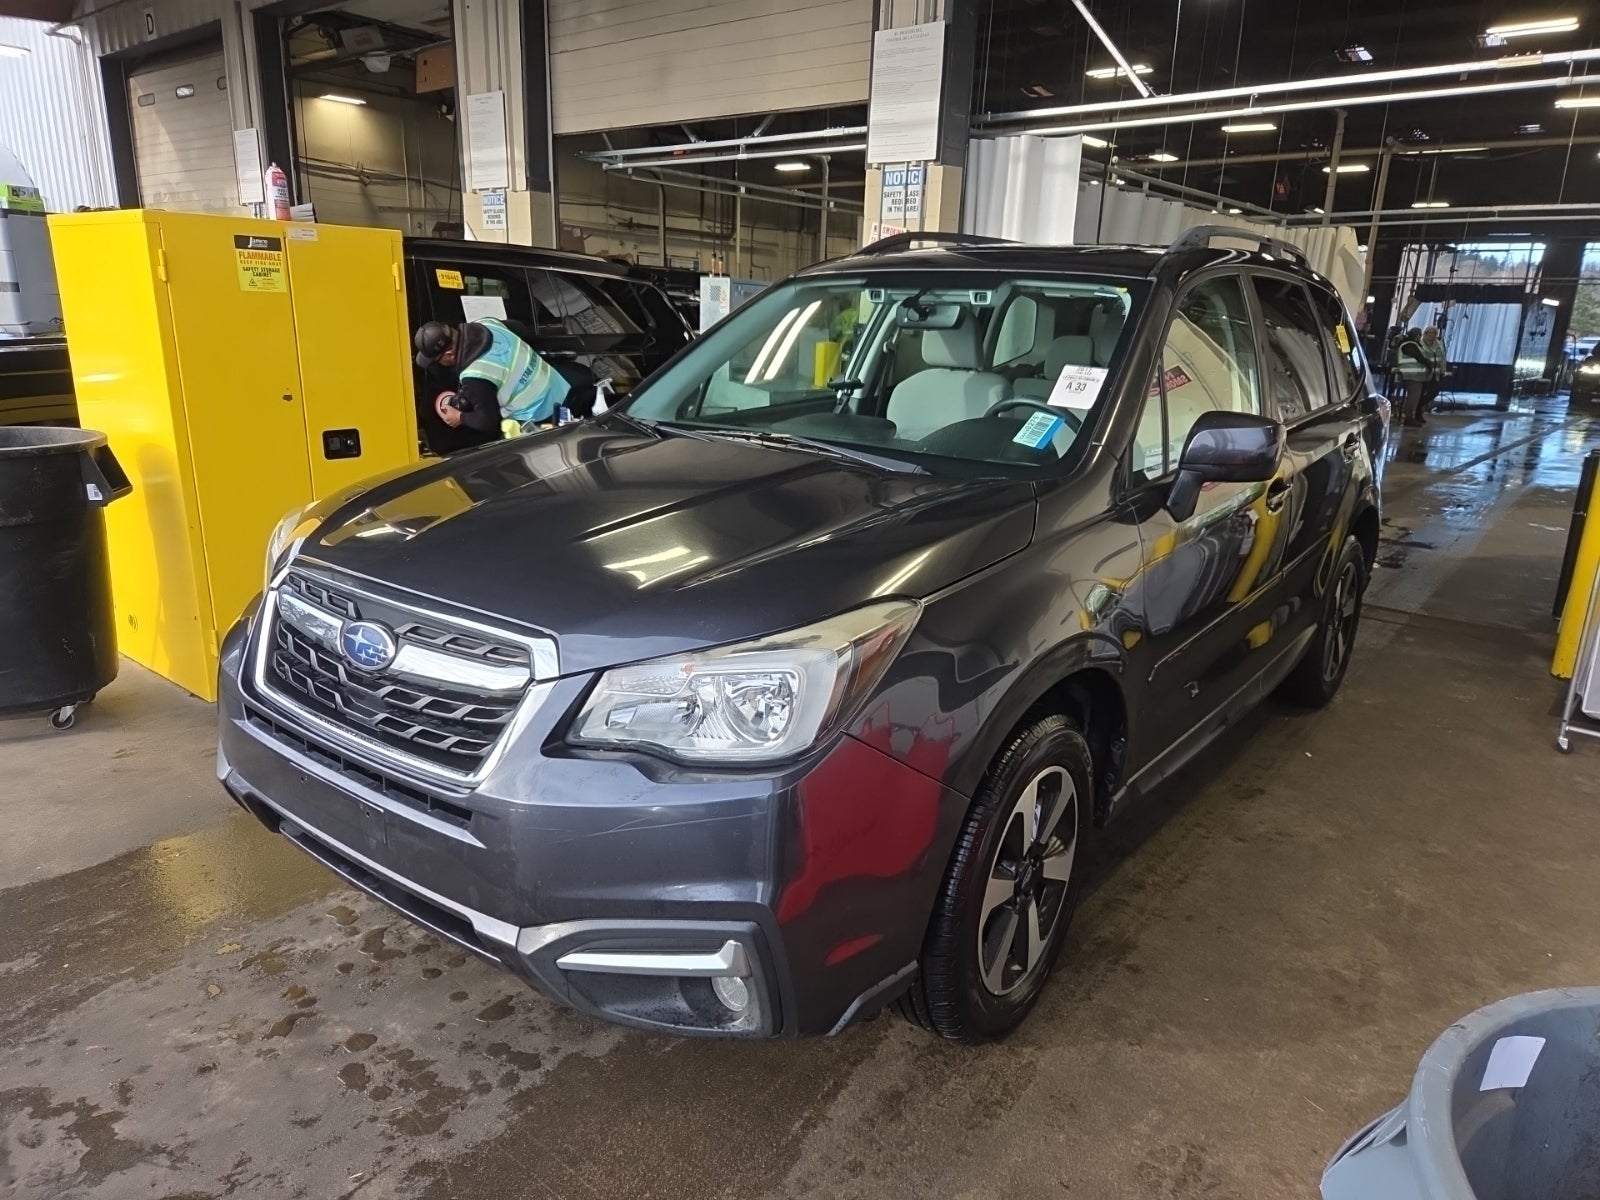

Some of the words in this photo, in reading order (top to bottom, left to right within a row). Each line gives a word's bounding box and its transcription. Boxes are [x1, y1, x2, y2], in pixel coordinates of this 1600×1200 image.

[146, 13, 154, 35] D
[892, 198, 917, 206] REQRED
[239, 252, 281, 261] FLAMMABLE
[1065, 382, 1073, 391] A
[1075, 383, 1087, 392] 33
